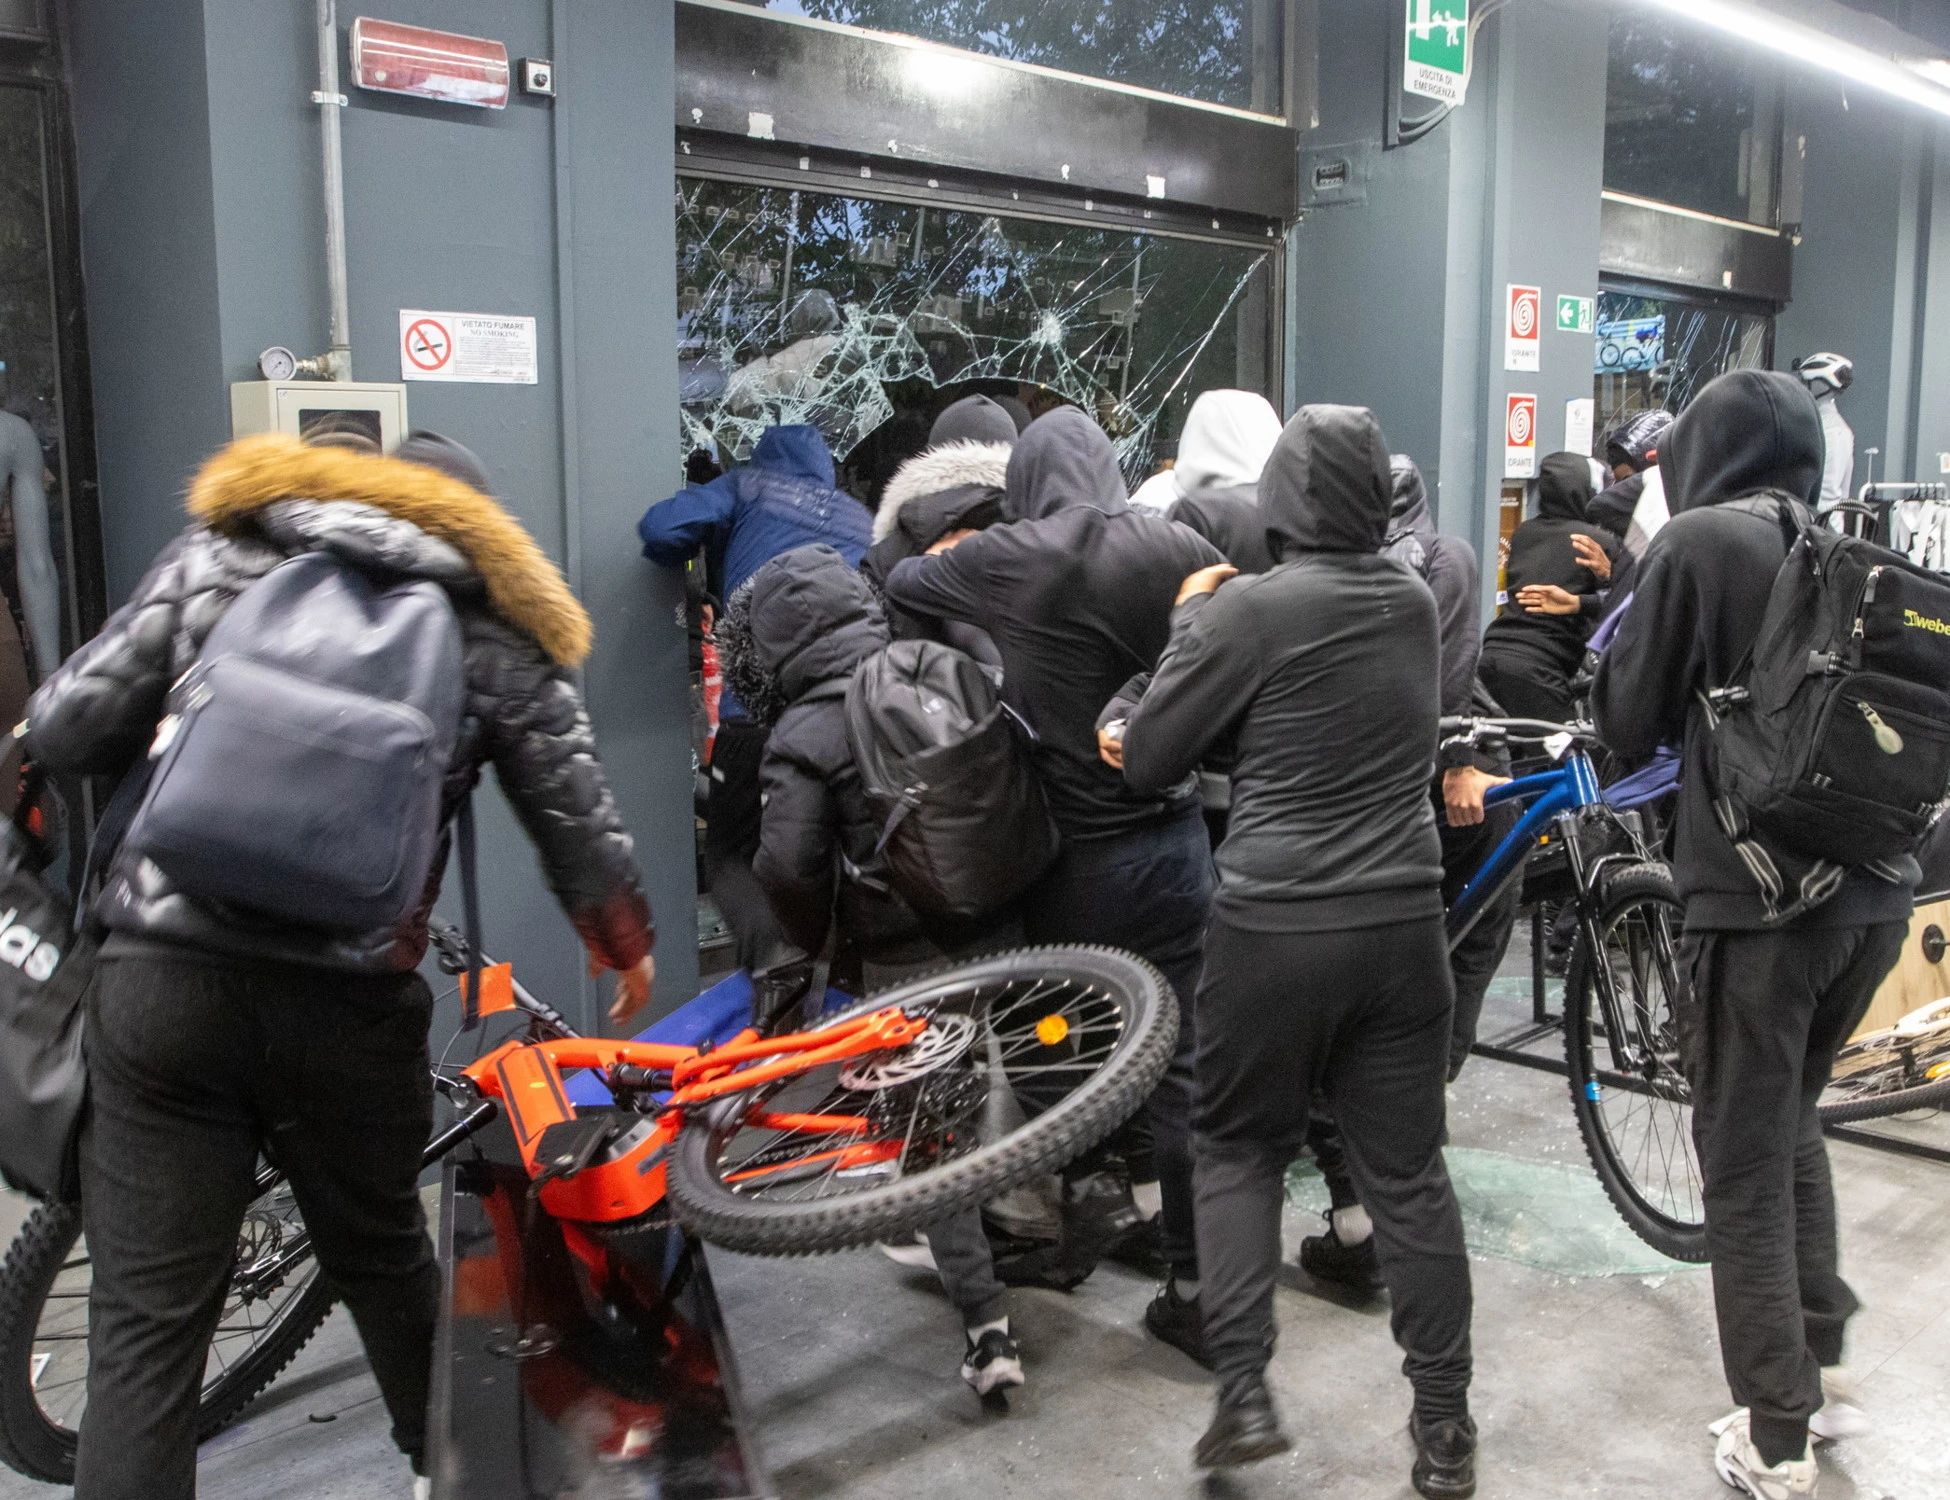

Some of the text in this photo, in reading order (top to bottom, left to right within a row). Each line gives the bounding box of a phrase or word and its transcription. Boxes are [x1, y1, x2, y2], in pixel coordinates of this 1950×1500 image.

[1419, 67, 1453, 86] USCITA DI
[1413, 80, 1456, 100] EMERGENZA
[461, 320, 525, 331] VIETATO FUMARE
[482, 329, 519, 338] SMOKING
